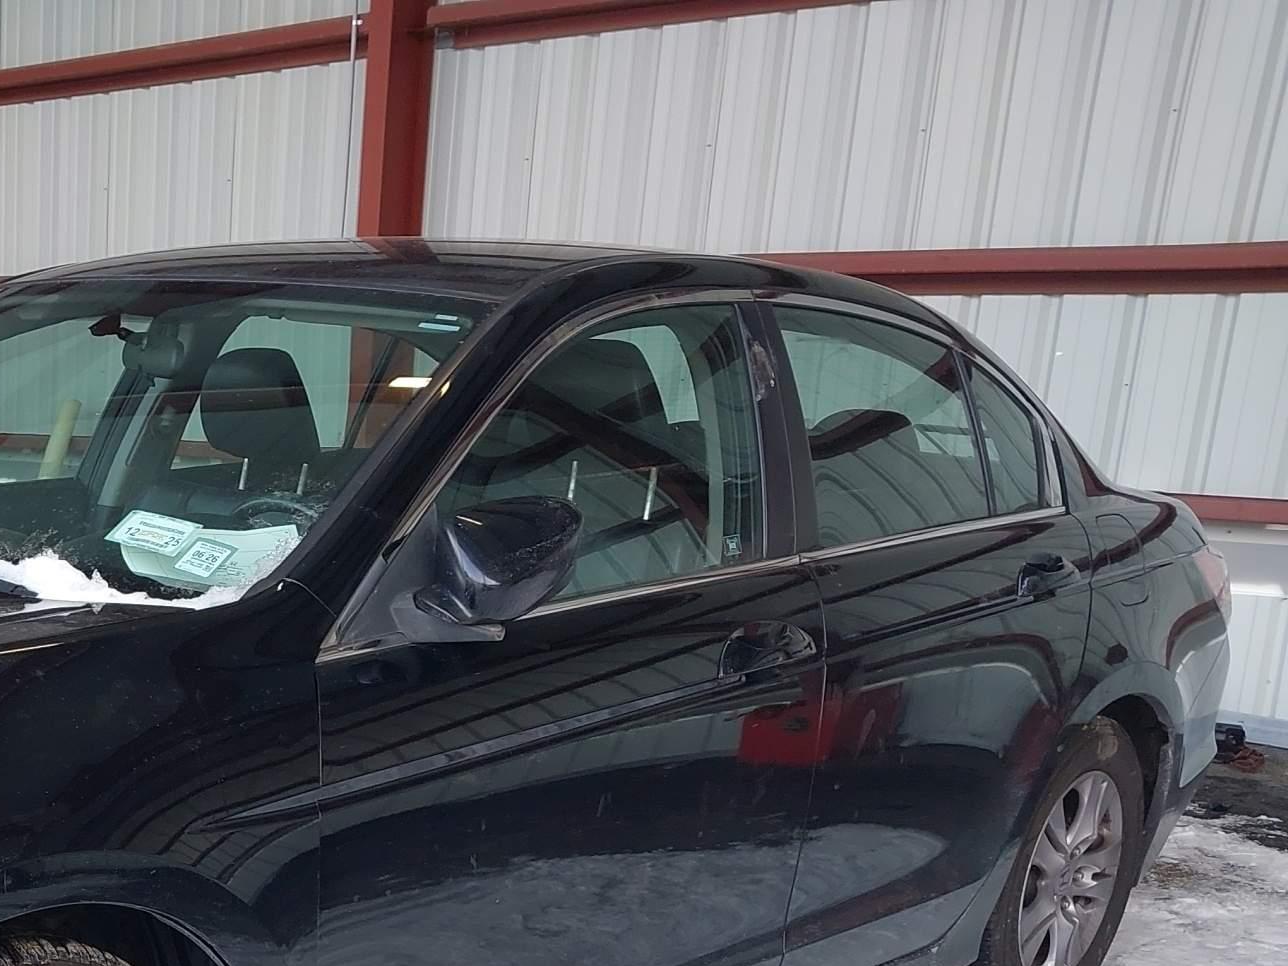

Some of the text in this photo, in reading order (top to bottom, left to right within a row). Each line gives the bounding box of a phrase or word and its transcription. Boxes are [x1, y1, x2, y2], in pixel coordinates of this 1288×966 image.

[124, 527, 141, 537] 12
[164, 536, 182, 547] 25
[192, 550, 220, 563] 06 26
